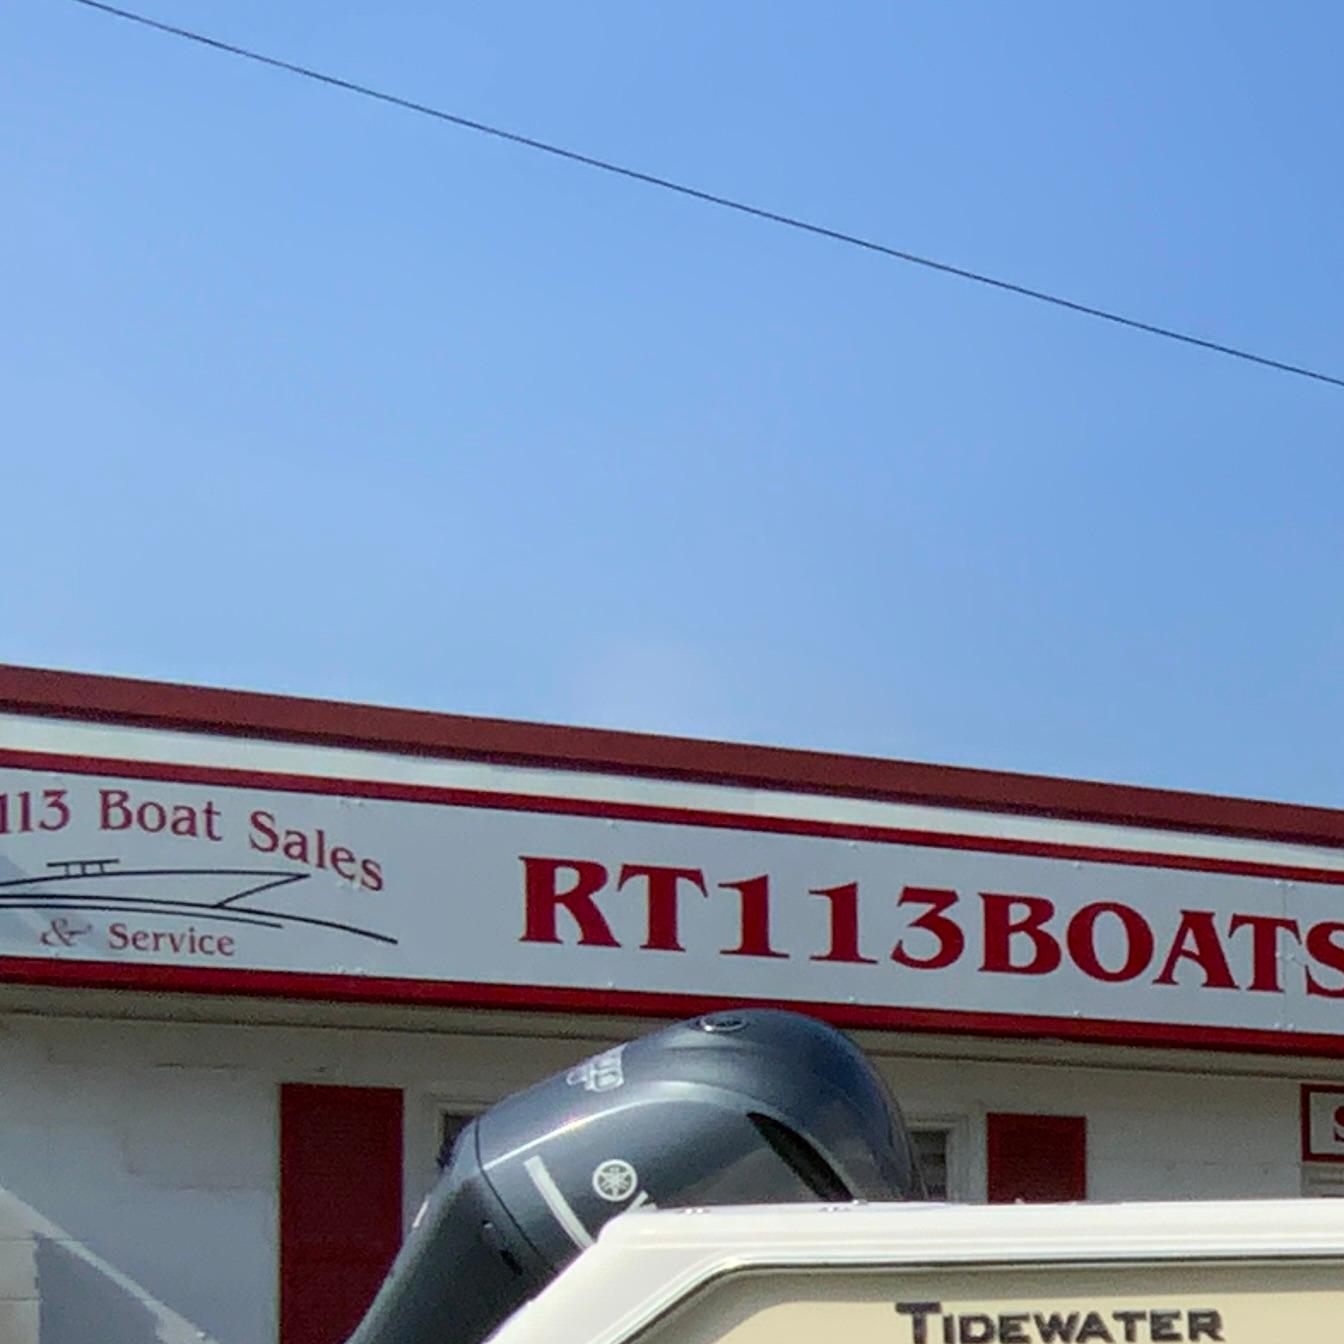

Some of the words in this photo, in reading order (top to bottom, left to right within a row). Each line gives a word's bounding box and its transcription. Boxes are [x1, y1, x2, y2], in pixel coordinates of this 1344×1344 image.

[100, 789, 222, 841] Boat
[248, 810, 385, 891] Sales
[39, 917, 92, 948] &
[108, 922, 236, 956] Service
